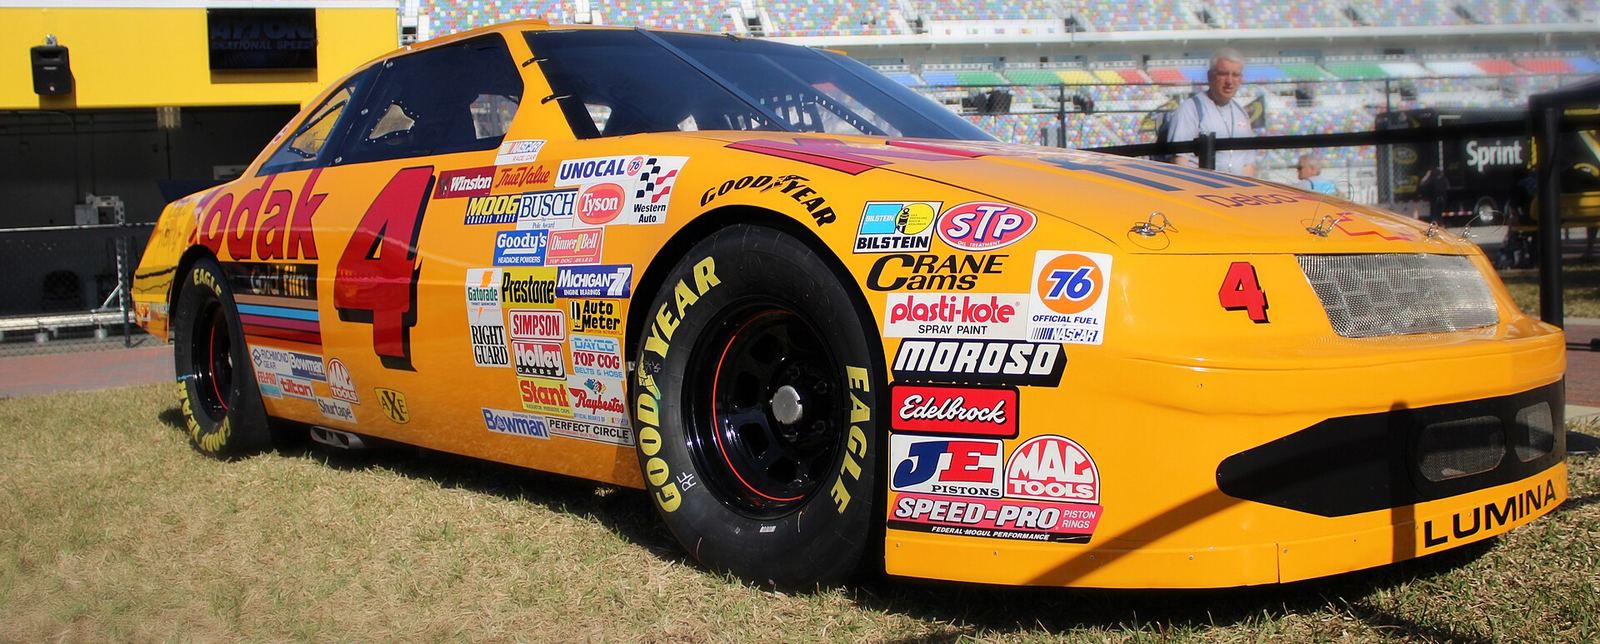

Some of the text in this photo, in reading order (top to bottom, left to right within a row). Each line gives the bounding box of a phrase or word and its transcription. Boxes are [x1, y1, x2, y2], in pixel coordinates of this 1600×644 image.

[1466, 140, 1522, 171] Sprint
[560, 159, 640, 180] UNOCAL 76
[450, 175, 492, 192] Winston
[466, 195, 522, 216] MOOG
[520, 193, 577, 218] BUSCH
[582, 193, 618, 216] Tyson
[634, 203, 666, 212] Western
[638, 213, 657, 223] Auto
[947, 205, 1025, 242] STP
[497, 232, 548, 255] Goody's
[551, 233, 598, 250] Dinner Bell
[856, 236, 929, 249] BILSTEIN
[333, 165, 435, 372] 4
[557, 269, 610, 288] MICHIGAN
[193, 268, 222, 297] EAGLE
[502, 272, 555, 304] Prestone
[1045, 267, 1094, 300] 76
[1218, 261, 1271, 324] 4
[467, 287, 498, 302] Gatorade
[583, 300, 613, 315] Auto
[890, 295, 1016, 324] plasti-kote
[513, 314, 560, 336] SIMPSON
[582, 314, 620, 331] Meter
[1032, 314, 1099, 325] OFFICIAL FUEL
[471, 325, 504, 345] RIGHT
[918, 325, 988, 335] SPRAY PAINT
[1053, 328, 1099, 342] NASCAR
[573, 337, 616, 352] DAYCO
[260, 349, 289, 363] RICHMOND
[263, 361, 277, 369] GEAR
[290, 354, 325, 374] Bowman
[474, 345, 509, 365] GUARD
[513, 343, 563, 376] Holley
[573, 352, 620, 369] TOP COG
[894, 341, 1060, 376] MOROSO
[517, 367, 551, 375] CARBS
[574, 366, 595, 375] BELTS
[603, 370, 624, 379] HOSE
[280, 378, 313, 397] tilton
[331, 386, 357, 401] TOOLS
[520, 380, 569, 407] Stant
[637, 256, 722, 513] GOODYEAR
[318, 399, 353, 420] Shurtape
[381, 390, 408, 421] AXE
[569, 388, 624, 414] Raybestos
[900, 395, 1006, 424] Edelbrock
[482, 409, 548, 438] Bowman
[549, 420, 590, 434] PERFECT
[593, 425, 629, 439] CIRCLE
[830, 365, 871, 514] EAGLE
[893, 441, 999, 488] JE
[1011, 440, 1094, 484] MAC
[676, 471, 697, 492] RF
[931, 485, 1000, 497] PISTONS
[1009, 480, 1094, 499] TOOLS
[896, 497, 1061, 529] SPEED-PRO
[1063, 510, 1096, 520] PISTON
[1424, 479, 1557, 549] LUMINA
[1062, 519, 1090, 529] RINGS
[993, 529, 1050, 541] PERFORMANCE
